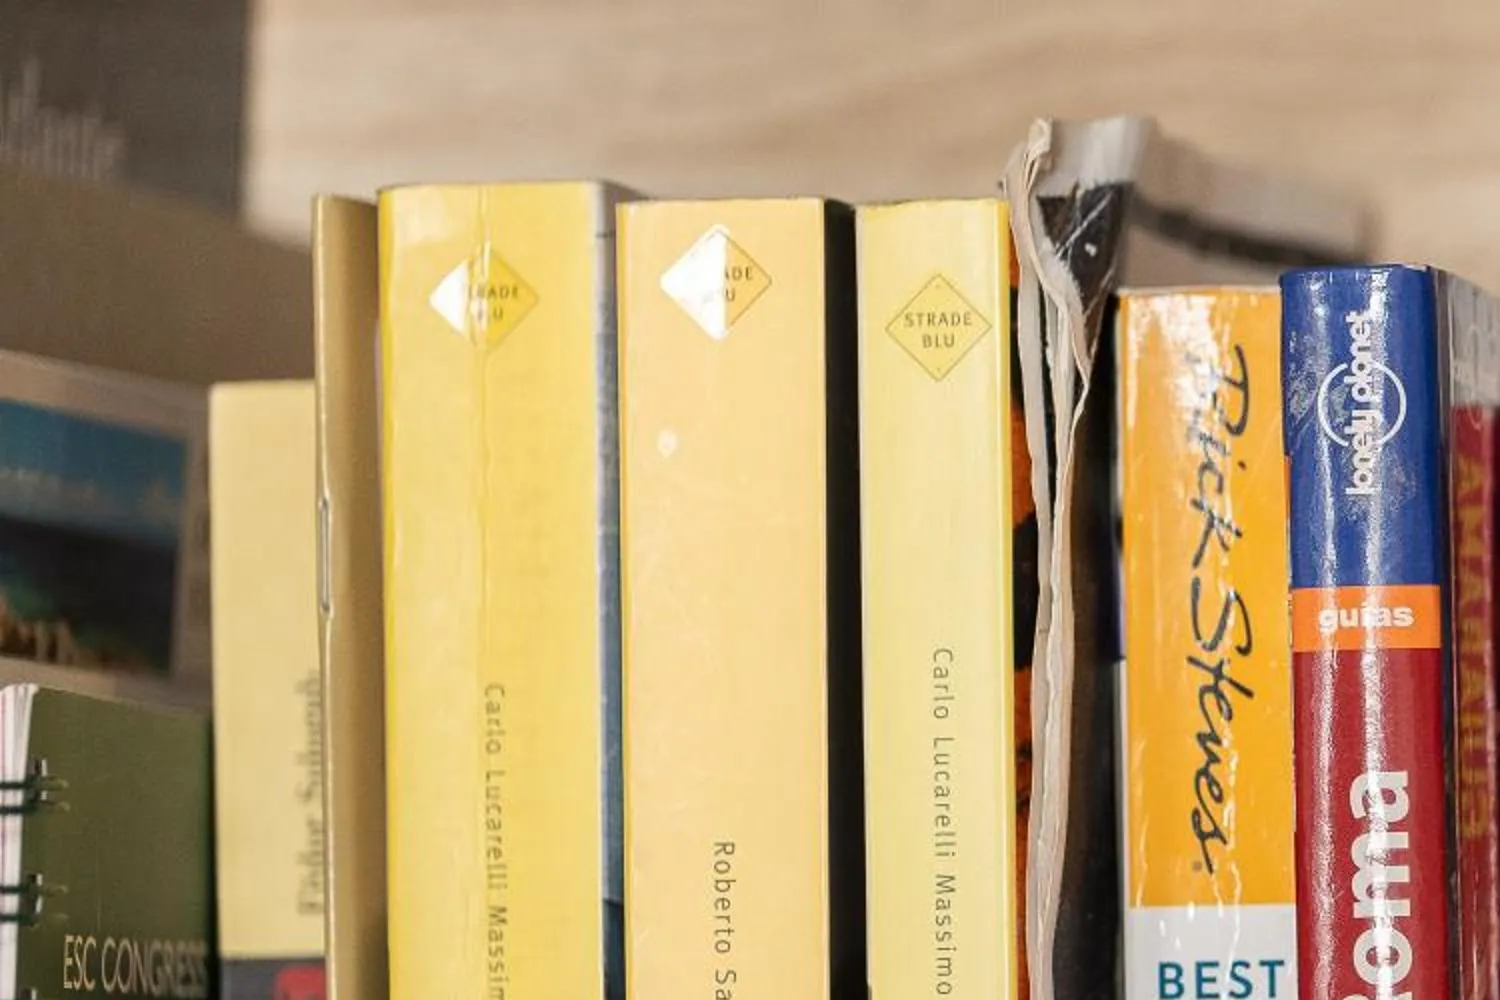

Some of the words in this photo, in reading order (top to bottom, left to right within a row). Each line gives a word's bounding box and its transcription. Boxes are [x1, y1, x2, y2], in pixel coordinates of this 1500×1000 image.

[903, 311, 973, 328] STRADE
[921, 332, 956, 349] BLU
[1343, 311, 1384, 402] planet
[1344, 409, 1383, 496] lonely
[484, 682, 506, 754] Carlo
[932, 647, 954, 720] Carlo
[485, 769, 509, 890] Lucarelli
[932, 737, 956, 858] Lucarelli
[713, 841, 737, 954] Roberto
[934, 873, 957, 997] Massimo
[62, 934, 97, 990] ESC
[1158, 960, 1284, 1000] BEST
